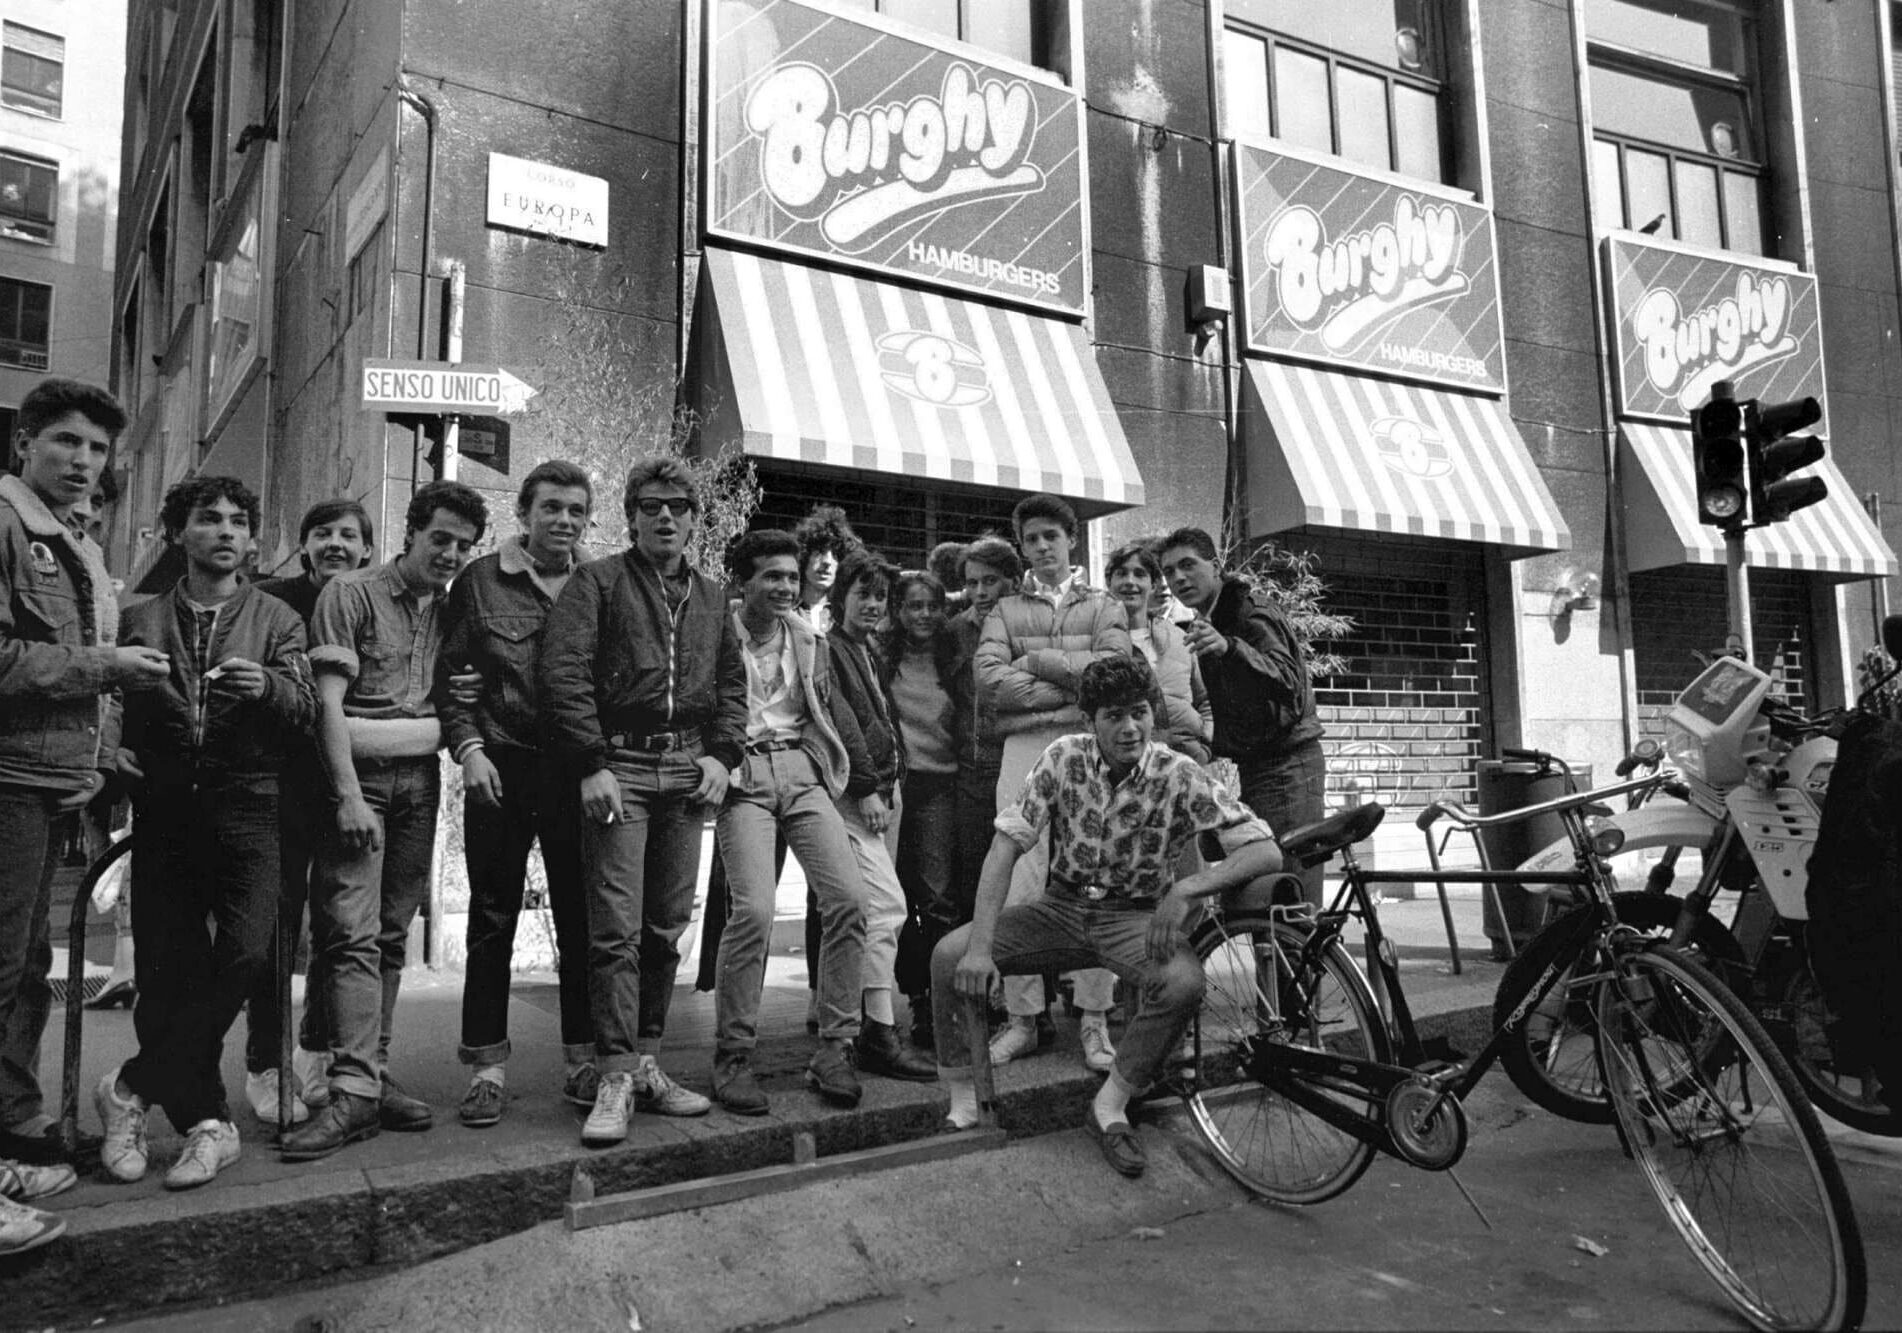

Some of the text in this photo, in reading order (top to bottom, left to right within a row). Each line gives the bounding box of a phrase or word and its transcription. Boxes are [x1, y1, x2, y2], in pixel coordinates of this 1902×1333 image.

[746, 64, 1032, 210] Burghy
[503, 191, 596, 227] EUROPA
[908, 240, 1062, 294] HAMBURGERS
[1266, 196, 1458, 323] Burghy
[1636, 272, 1788, 390] Burghy
[366, 371, 501, 402] SENSO UNICO
[1380, 342, 1488, 378] HAMBURGERS
